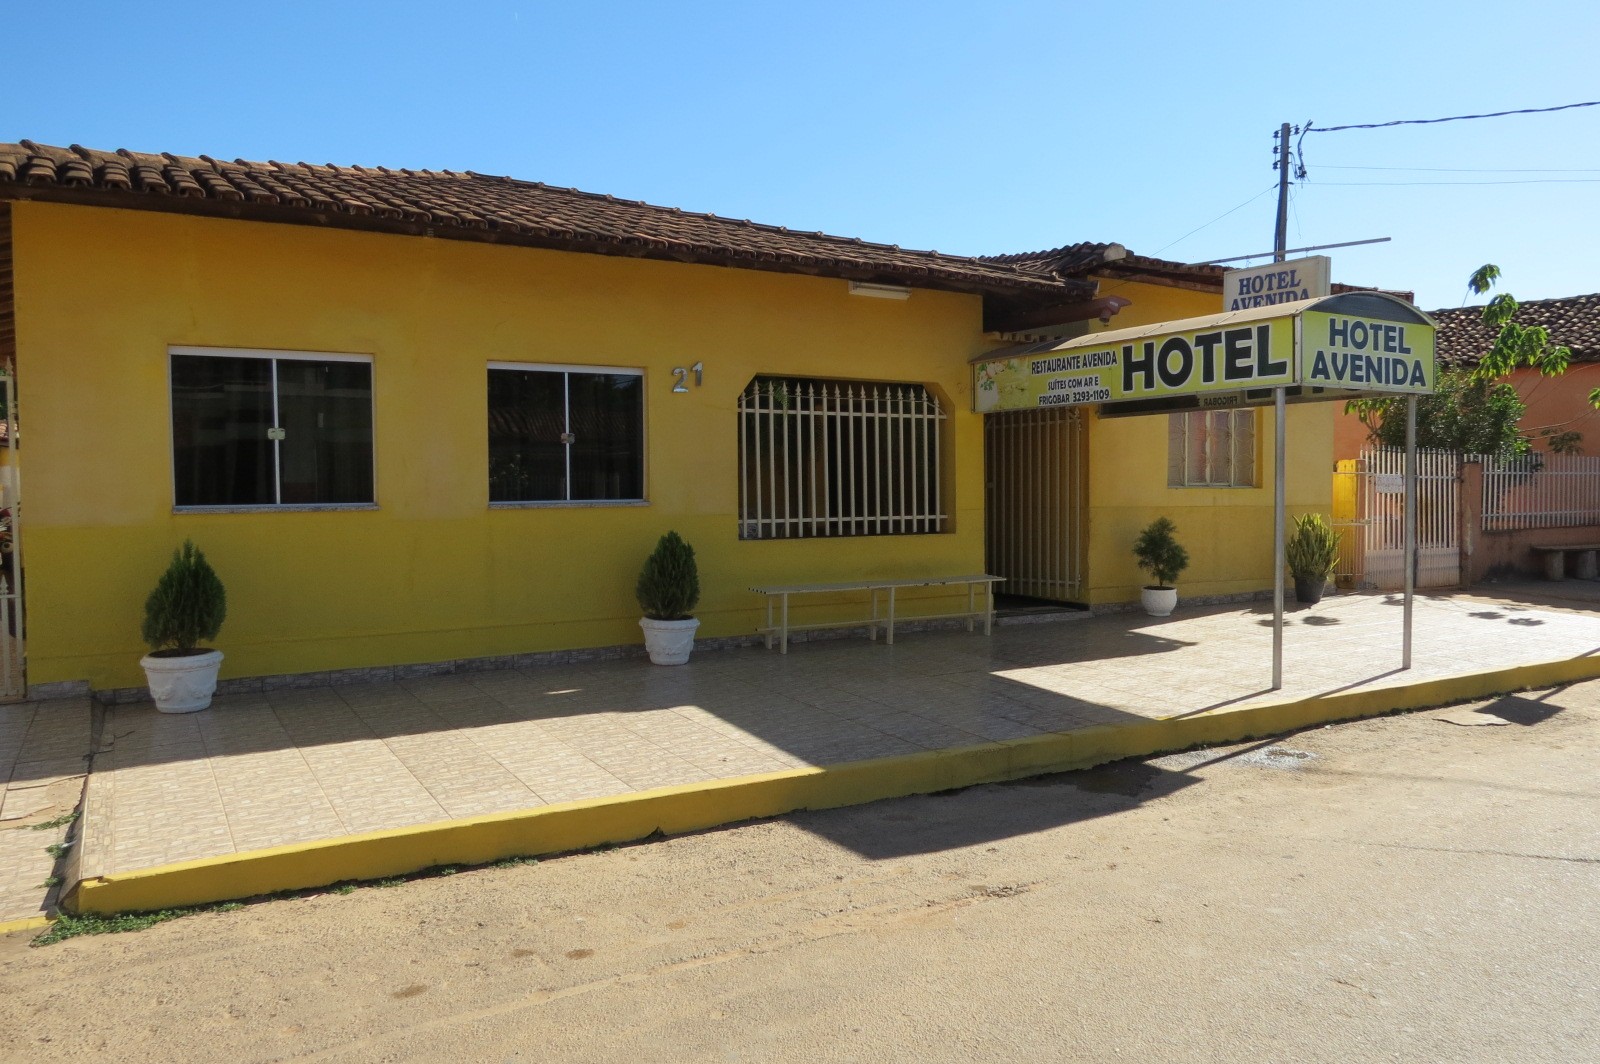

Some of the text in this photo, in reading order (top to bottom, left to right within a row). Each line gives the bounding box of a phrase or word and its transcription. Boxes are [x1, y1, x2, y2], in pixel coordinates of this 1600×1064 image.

[1238, 270, 1301, 296] HOTEL
[1329, 318, 1411, 354] HOTEL
[1031, 351, 1117, 374] RESTAURANTE AVENIDA
[1122, 324, 1287, 391] HOTEL
[1311, 351, 1426, 386] AVENIDA
[672, 361, 703, 392] 21
[1048, 376, 1099, 391] SUÍTES COM AR E
[1038, 389, 1109, 405] FRIGOBAR 3293-1109
